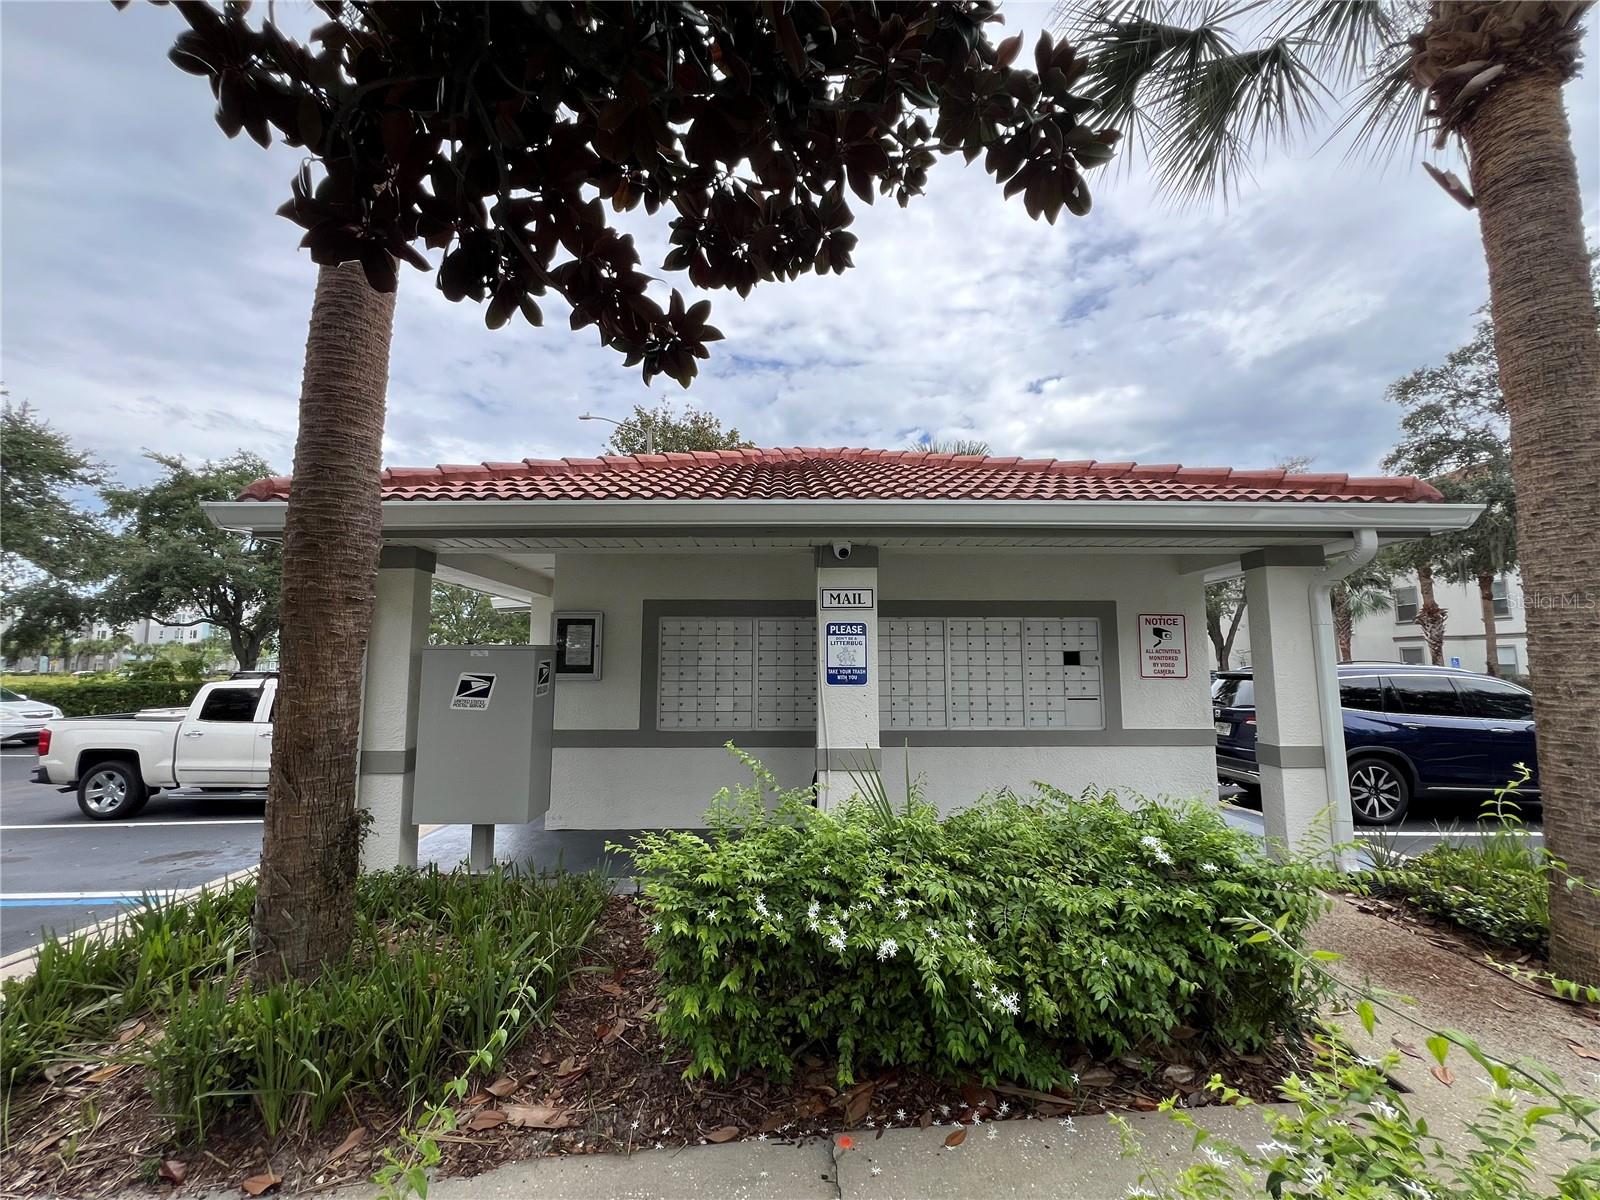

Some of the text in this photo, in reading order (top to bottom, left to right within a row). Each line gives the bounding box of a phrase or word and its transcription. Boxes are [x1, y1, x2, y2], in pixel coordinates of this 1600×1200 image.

[829, 592, 866, 605] MAIL
[1145, 618, 1179, 626] NOTICE
[830, 625, 863, 634] PLEASE
